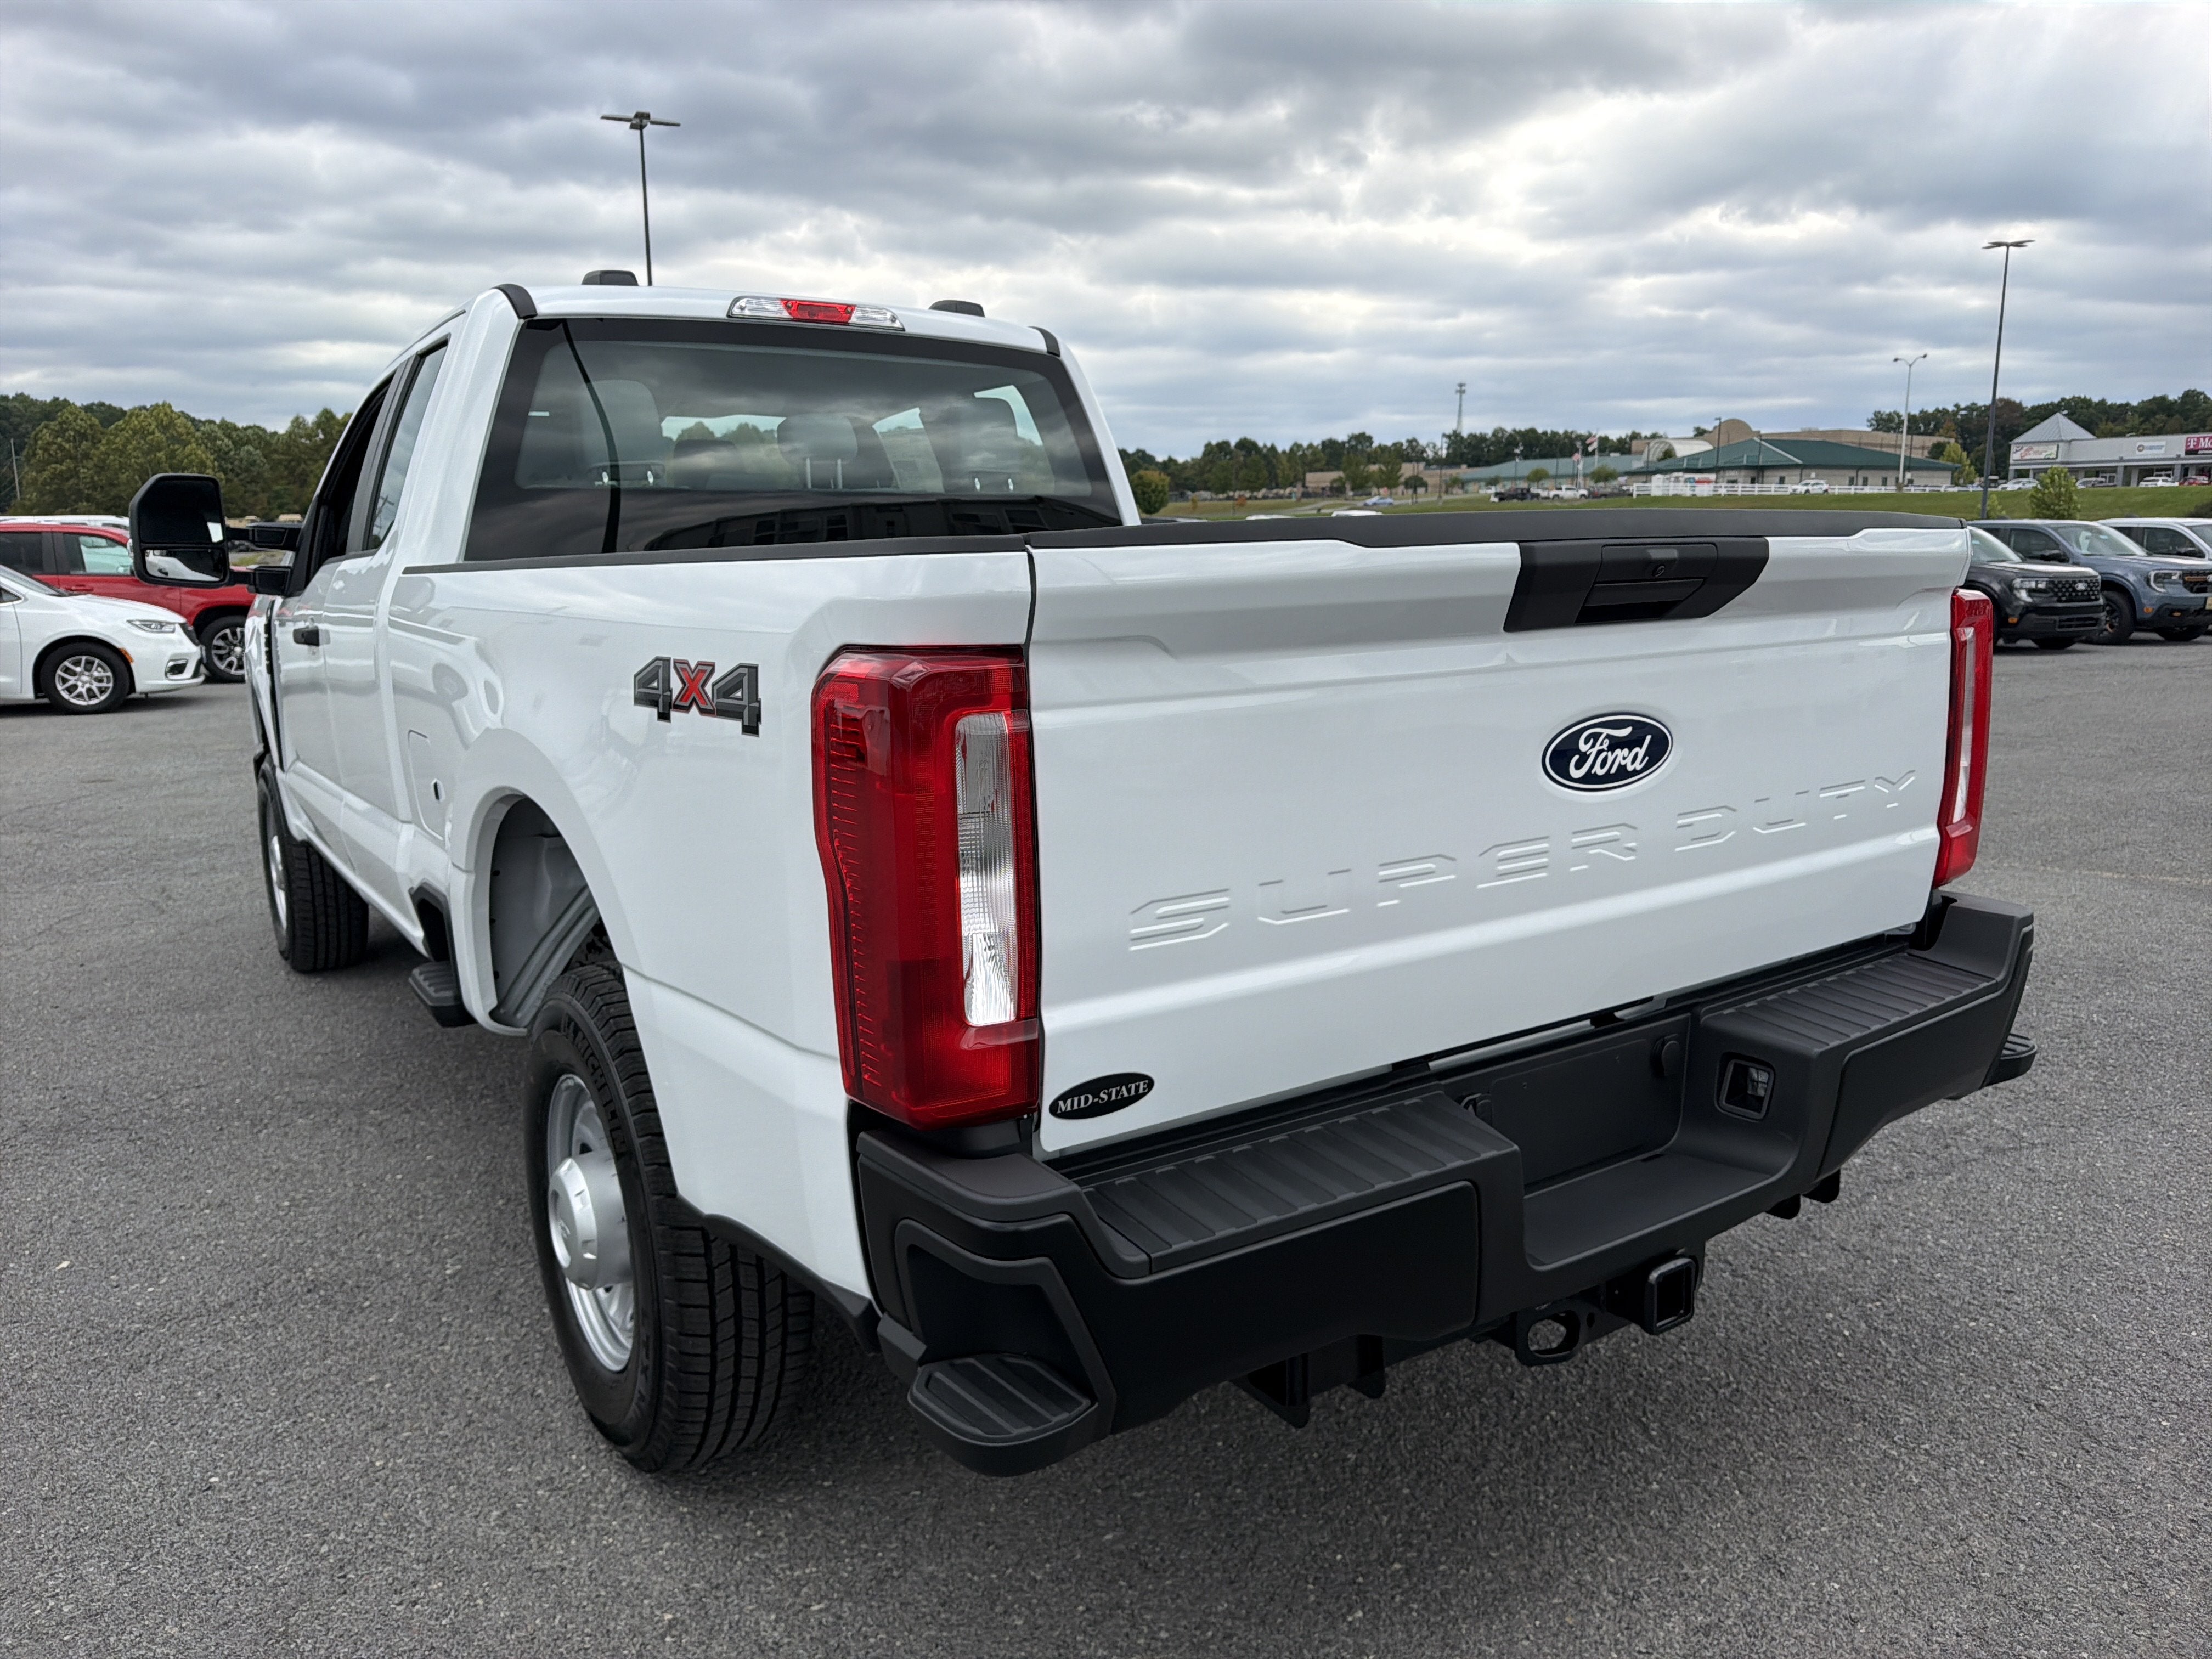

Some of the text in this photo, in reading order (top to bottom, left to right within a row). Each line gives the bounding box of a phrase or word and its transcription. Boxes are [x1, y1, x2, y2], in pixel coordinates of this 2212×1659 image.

[634, 656, 762, 738] 4X4
[1569, 726, 1652, 779] Ford
[1128, 770, 1916, 951] SUPER DUTY
[1056, 1079, 1149, 1114] MID-STATE
